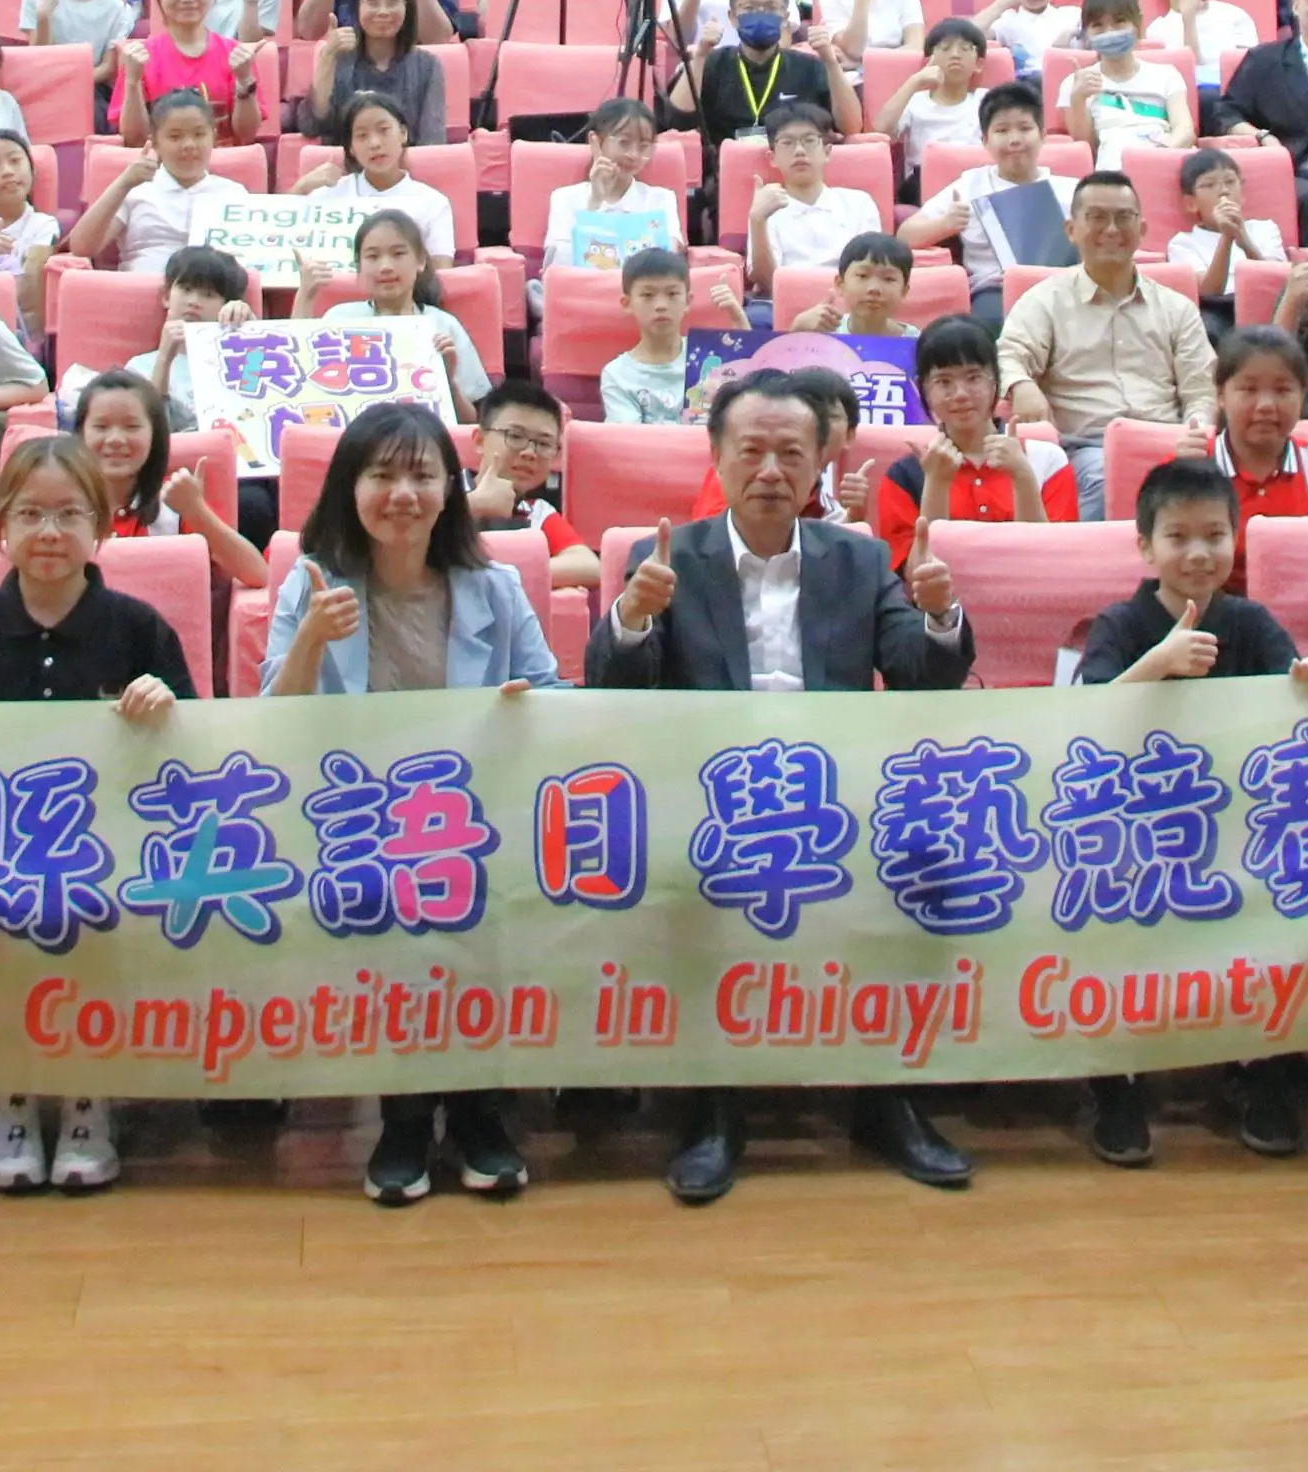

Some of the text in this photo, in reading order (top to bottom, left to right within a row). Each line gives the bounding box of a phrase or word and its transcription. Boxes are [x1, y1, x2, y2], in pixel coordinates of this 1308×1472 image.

[205, 227, 355, 249] Readin
[223, 204, 368, 227] English
[217, 328, 396, 397] 英語
[24, 965, 554, 1078] Competition
[595, 962, 673, 1043] in
[716, 958, 979, 1063] Chiayi
